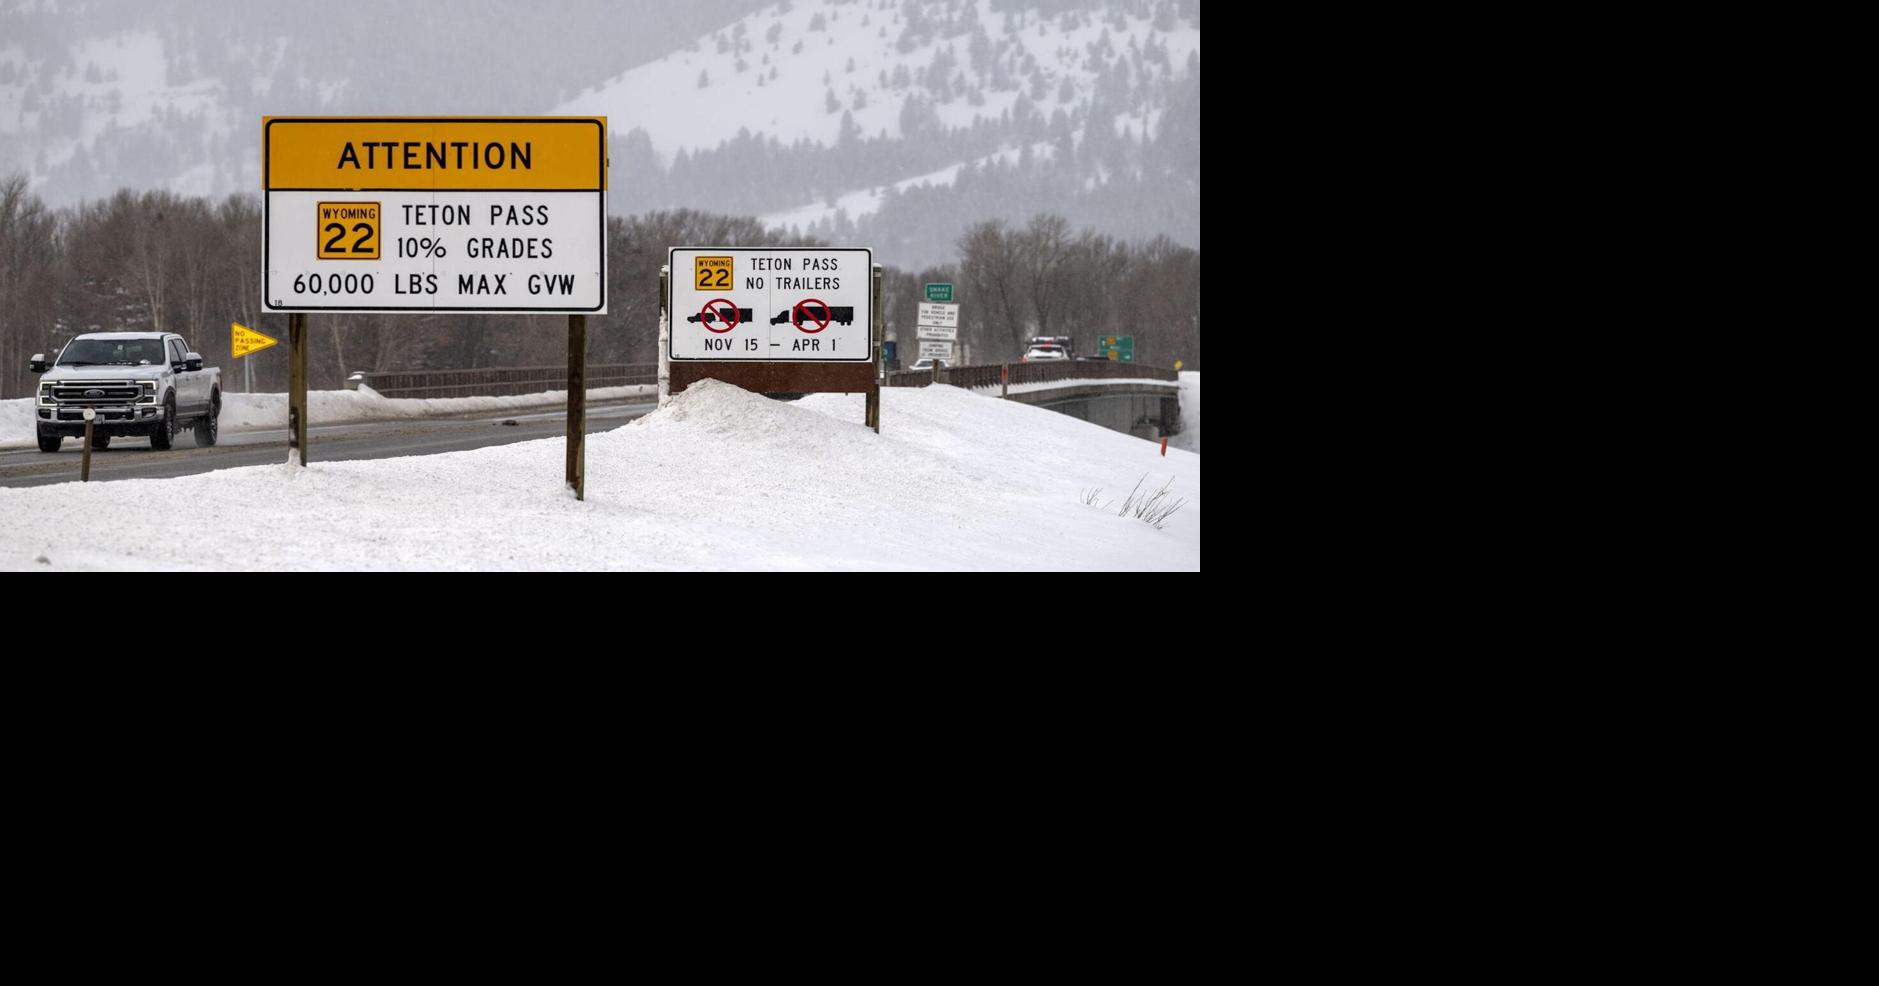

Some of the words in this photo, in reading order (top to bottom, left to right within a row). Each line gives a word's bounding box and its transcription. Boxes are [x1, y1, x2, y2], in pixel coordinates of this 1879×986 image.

[338, 142, 531, 169] ATTENTION
[323, 209, 375, 219] WYOMING
[402, 205, 470, 225] TETON
[491, 205, 548, 225] PASS
[324, 223, 373, 253] 22
[398, 238, 446, 258] 10%
[467, 238, 552, 258] GRADES
[751, 258, 791, 270] TETON
[803, 258, 837, 270] PASS
[294, 274, 374, 296] 60,000
[395, 274, 437, 294] LBS
[459, 274, 506, 295] MAX
[528, 274, 574, 295] GVW
[700, 269, 729, 286] 22
[747, 277, 763, 289] NO
[776, 277, 839, 289] TRAILERS
[705, 339, 732, 350] NOV
[745, 339, 757, 351] 15
[793, 339, 819, 351] APR
[832, 339, 835, 351] 1
